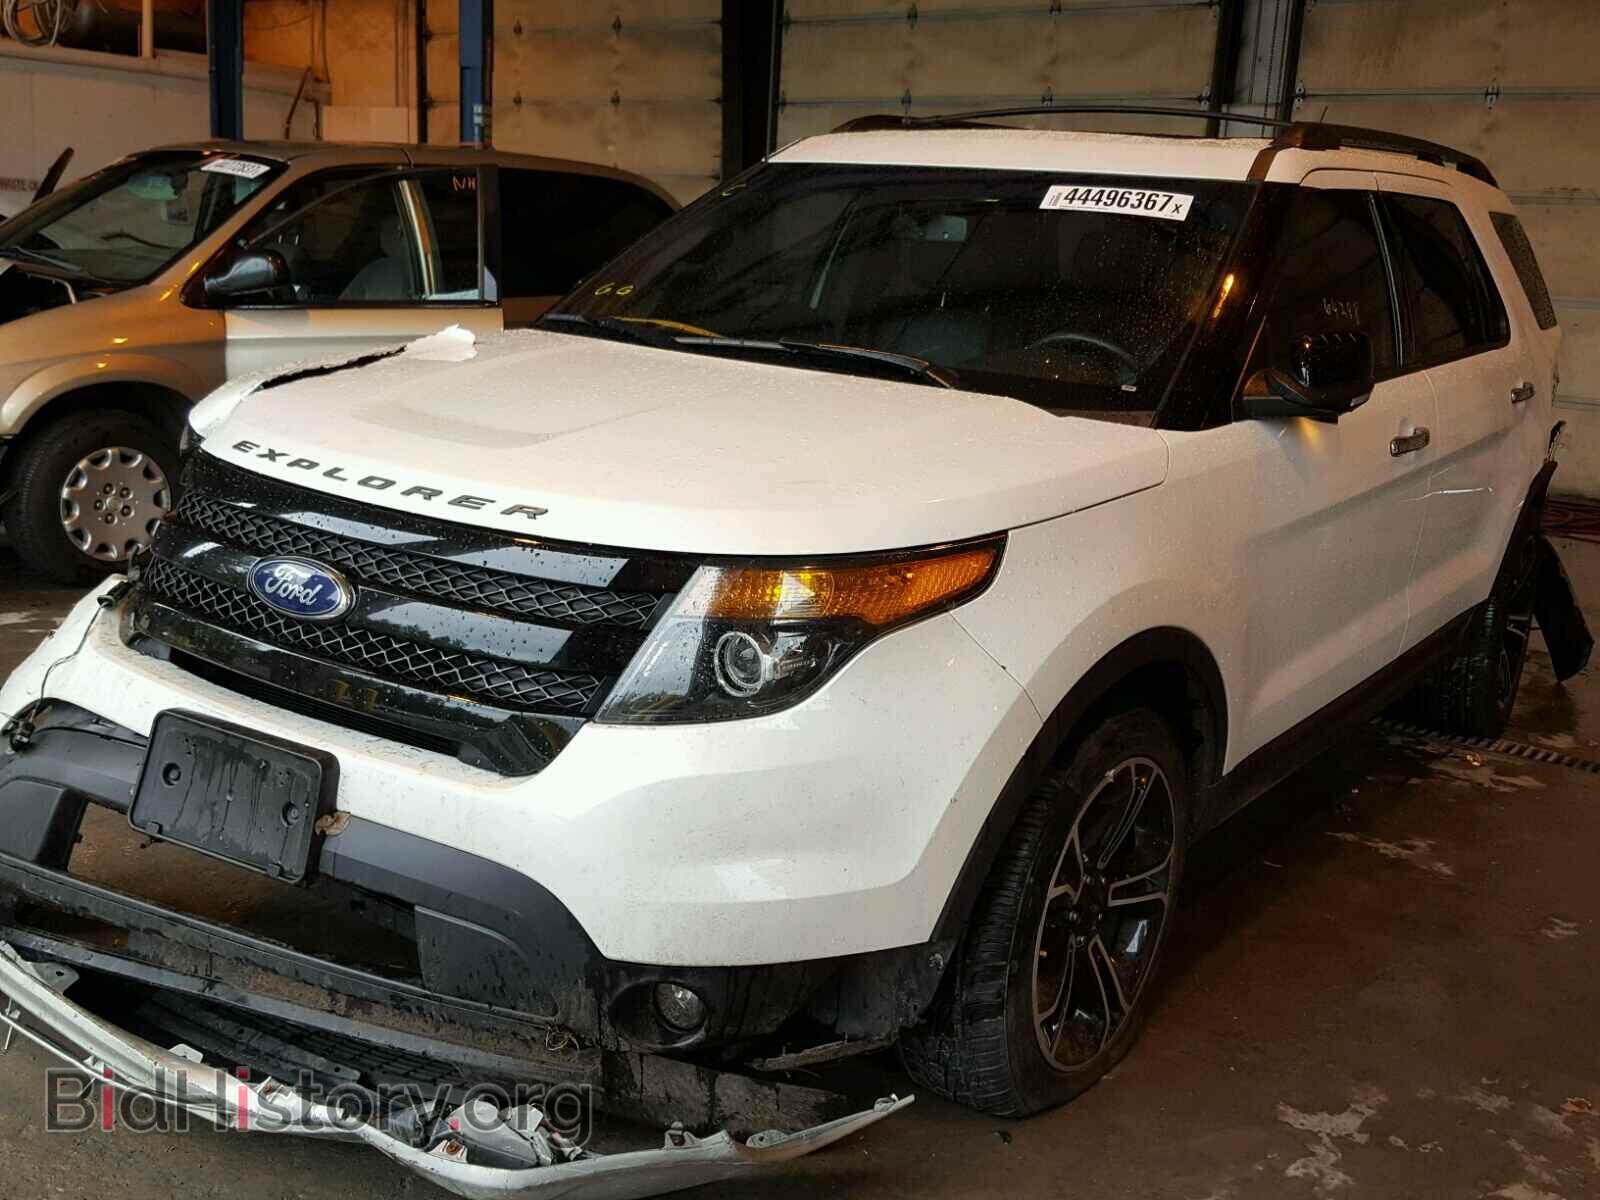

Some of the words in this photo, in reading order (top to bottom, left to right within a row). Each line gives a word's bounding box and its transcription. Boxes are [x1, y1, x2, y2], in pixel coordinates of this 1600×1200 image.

[1064, 188, 1174, 212] 44496367
[232, 440, 549, 520] EXPLORER
[264, 564, 322, 606] Ford
